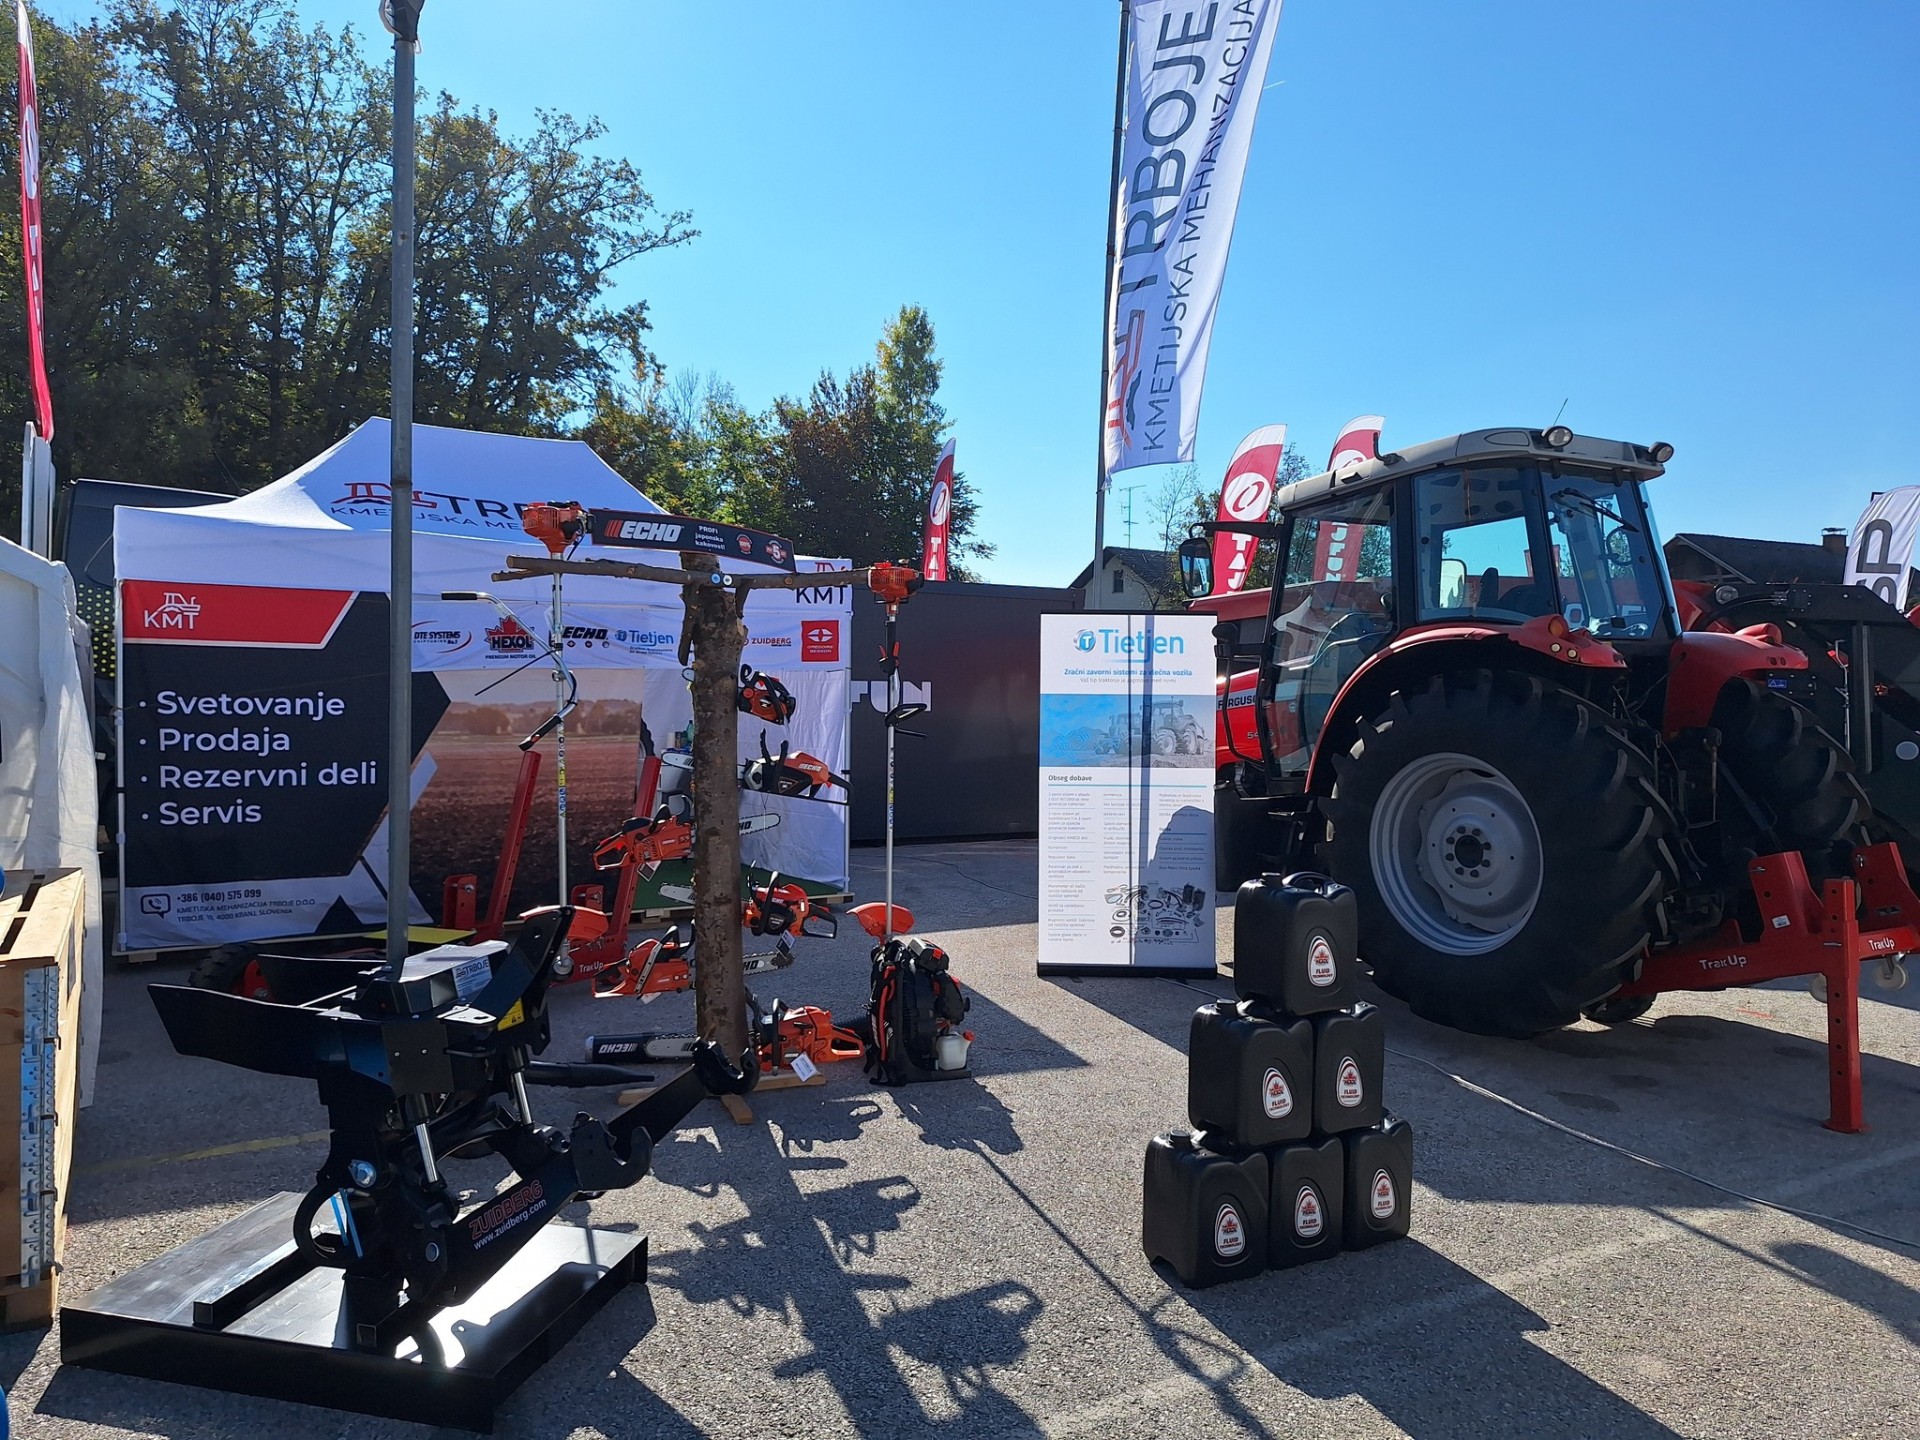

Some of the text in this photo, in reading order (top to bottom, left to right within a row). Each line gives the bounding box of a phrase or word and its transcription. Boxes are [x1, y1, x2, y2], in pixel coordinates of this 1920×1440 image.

[1143, 0, 1256, 451] KMETIJSKA MEHANIZACIJA
[331, 506, 478, 527] KMEJSKA
[620, 520, 682, 542] ECHO
[695, 532, 724, 542] japonska
[698, 525, 718, 534] PROFI
[1227, 533, 1252, 595] TAJ
[796, 585, 848, 605] KMT
[143, 609, 200, 630] KMT
[413, 630, 461, 640] DTE SYSTEMS
[491, 635, 533, 649] HEXOL
[561, 626, 608, 640] ECHO
[628, 629, 674, 646] Tietjen
[751, 637, 792, 645] ZUIDBERG
[1098, 628, 1184, 663] Tietjen
[1064, 667, 1085, 676] Zračni
[1086, 668, 1112, 676] zavorni
[1172, 668, 1193, 676] vozila
[157, 690, 345, 721] Svetovanje
[1217, 694, 1256, 707] FRGUS
[159, 727, 291, 757] Prodaja
[160, 760, 377, 788] Rezervni deli
[1048, 774, 1093, 782] Obseg dobave
[159, 798, 262, 825] Servis
[176, 888, 262, 903] +386 (040) 575 099
[598, 1043, 631, 1054] ECHO
[1271, 1098, 1287, 1107] FLUID
[468, 1179, 544, 1242] ZUIDBERG
[473, 1198, 548, 1251] www.zuidberg.com
